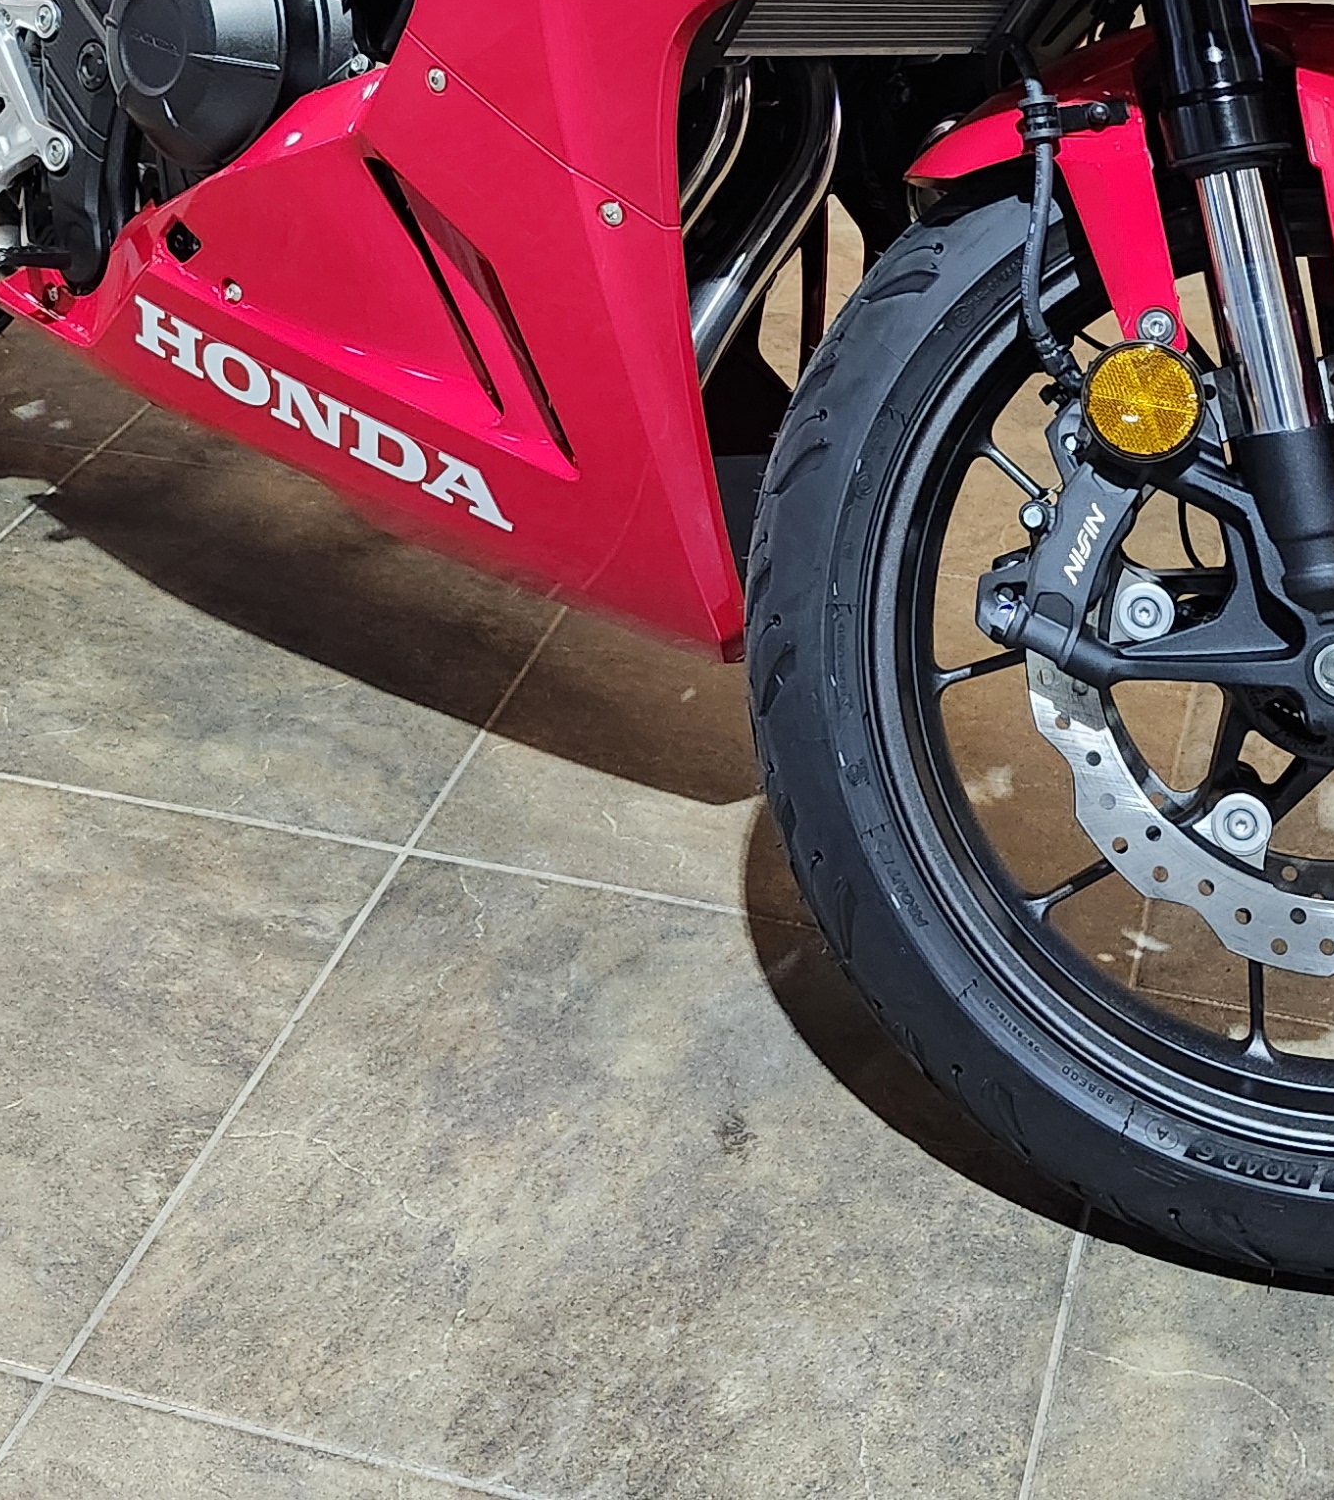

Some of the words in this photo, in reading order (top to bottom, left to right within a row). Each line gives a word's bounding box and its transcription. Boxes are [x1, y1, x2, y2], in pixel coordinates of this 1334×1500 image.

[133, 293, 514, 533] HONDA
[1063, 502, 1107, 586] NISSIN
[1222, 1151, 1304, 1185] ROAD
